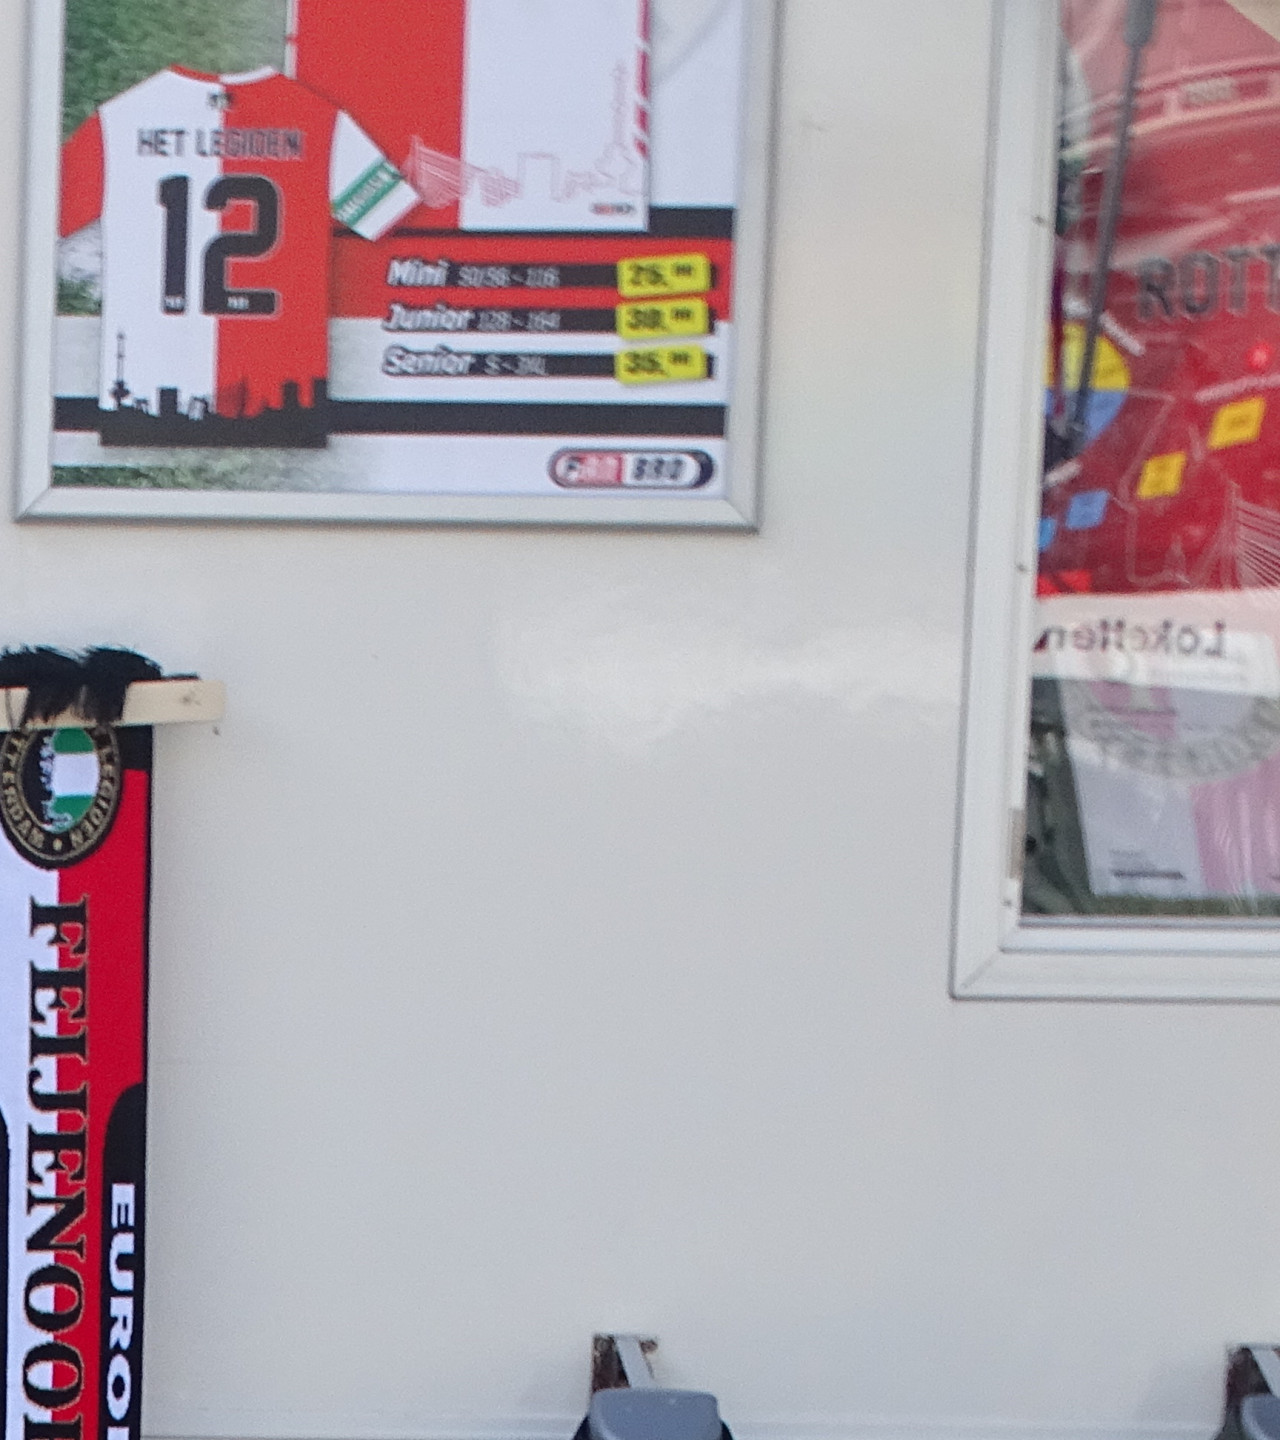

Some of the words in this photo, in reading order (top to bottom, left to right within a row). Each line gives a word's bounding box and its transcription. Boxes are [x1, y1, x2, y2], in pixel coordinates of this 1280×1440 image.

[138, 128, 187, 156] HET
[159, 174, 280, 314] 12
[388, 258, 450, 287] Mini
[382, 302, 474, 331] Junior
[382, 345, 474, 376] Senior
